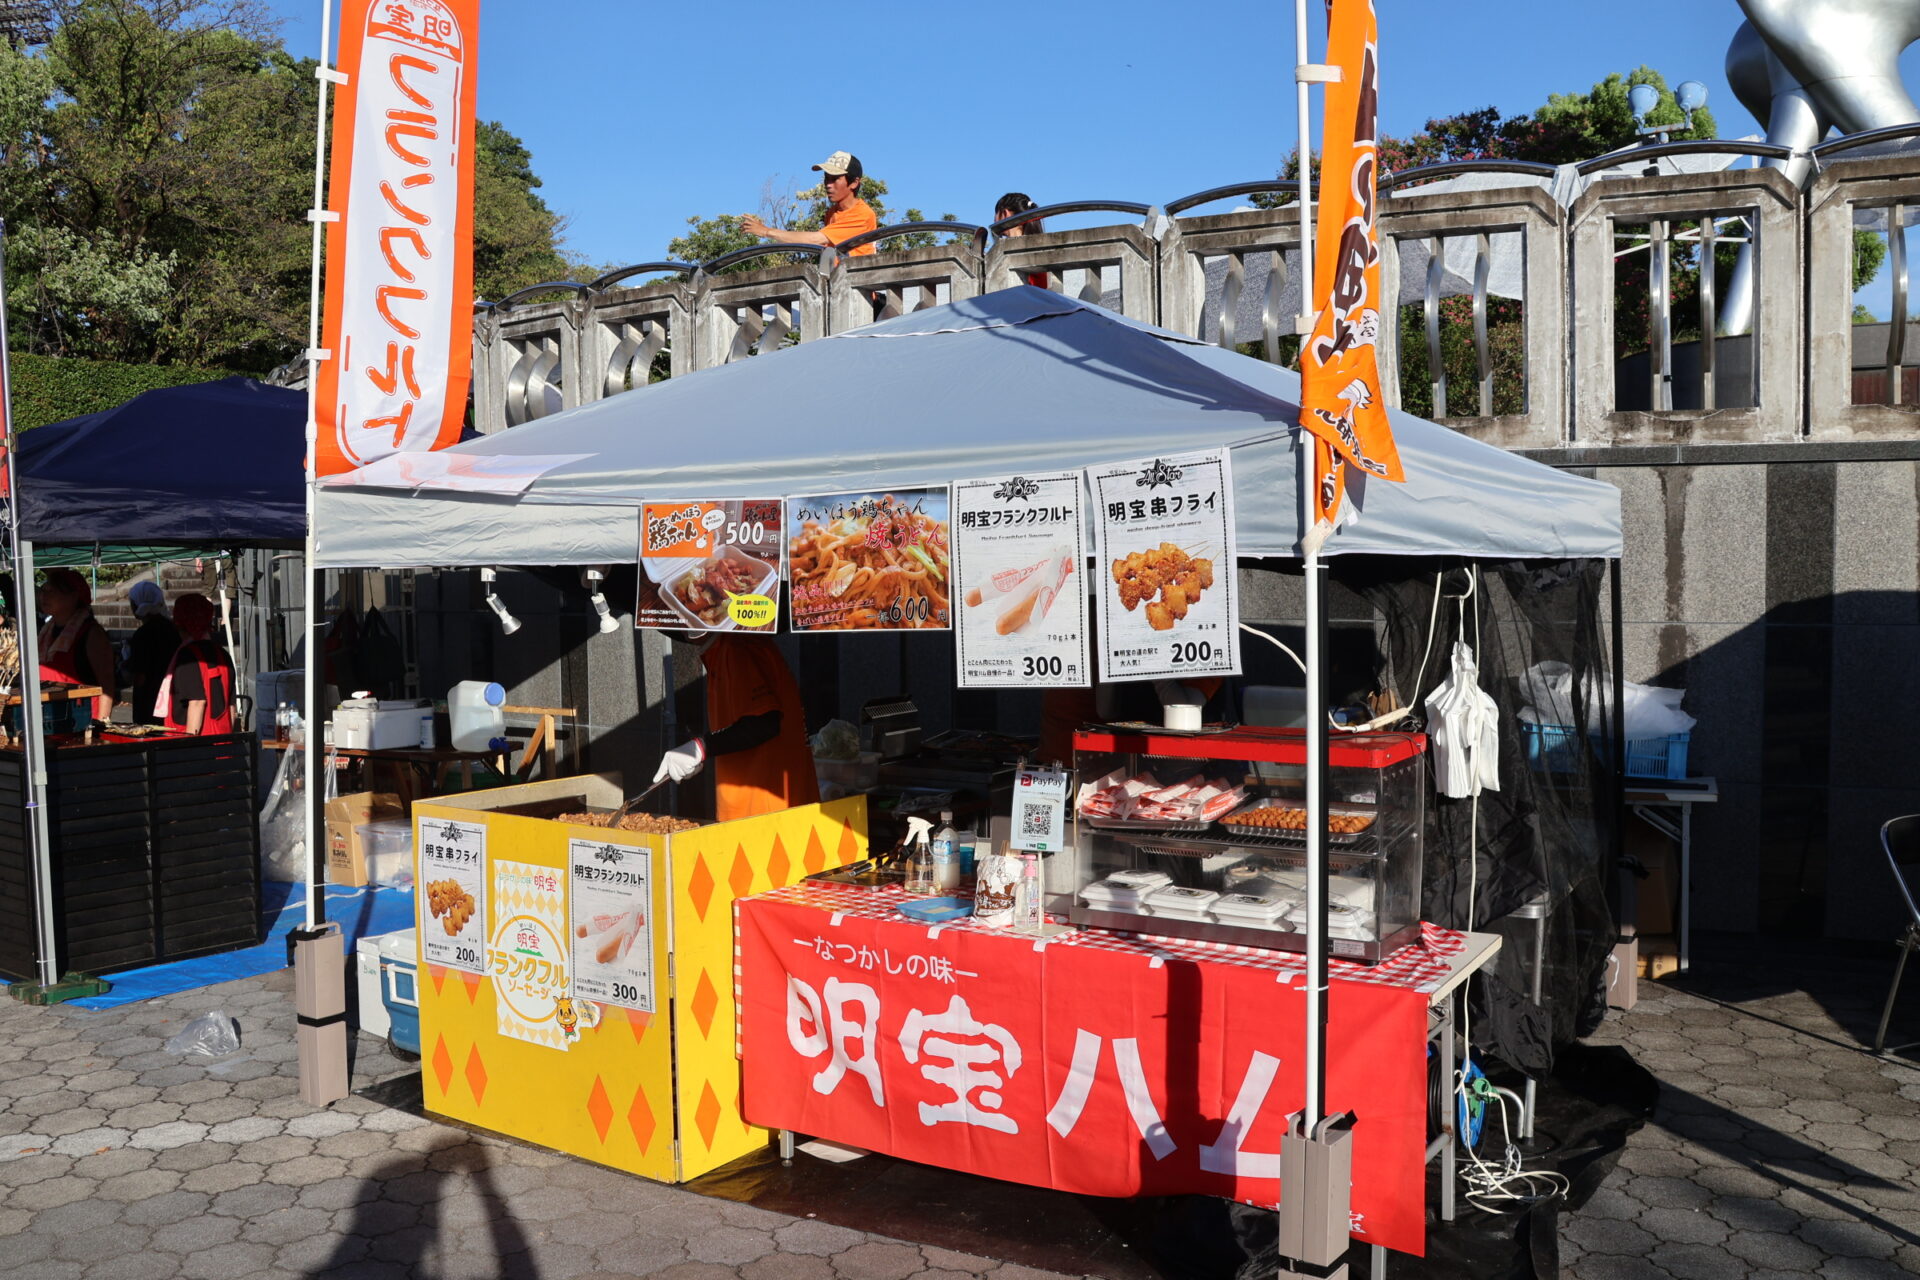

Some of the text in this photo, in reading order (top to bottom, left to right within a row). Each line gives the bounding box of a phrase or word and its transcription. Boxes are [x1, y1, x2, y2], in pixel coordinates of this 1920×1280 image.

[796, 497, 928, 521] めいほう鶏ちゃん
[961, 505, 1073, 528] 明宝フランクフルト
[1107, 491, 1217, 521] 明宝串フライ
[865, 523, 945, 550] 焼うどん
[1032, 776, 1063, 788] PayPay
[425, 843, 478, 863] 明宝串フライ
[534, 876, 557, 893] 明宝
[575, 864, 645, 886] 明宝フランクフルト
[517, 933, 540, 949] 明宝
[508, 979, 551, 1000] ソーセージ
[786, 973, 1351, 1184] 明宝ハム
